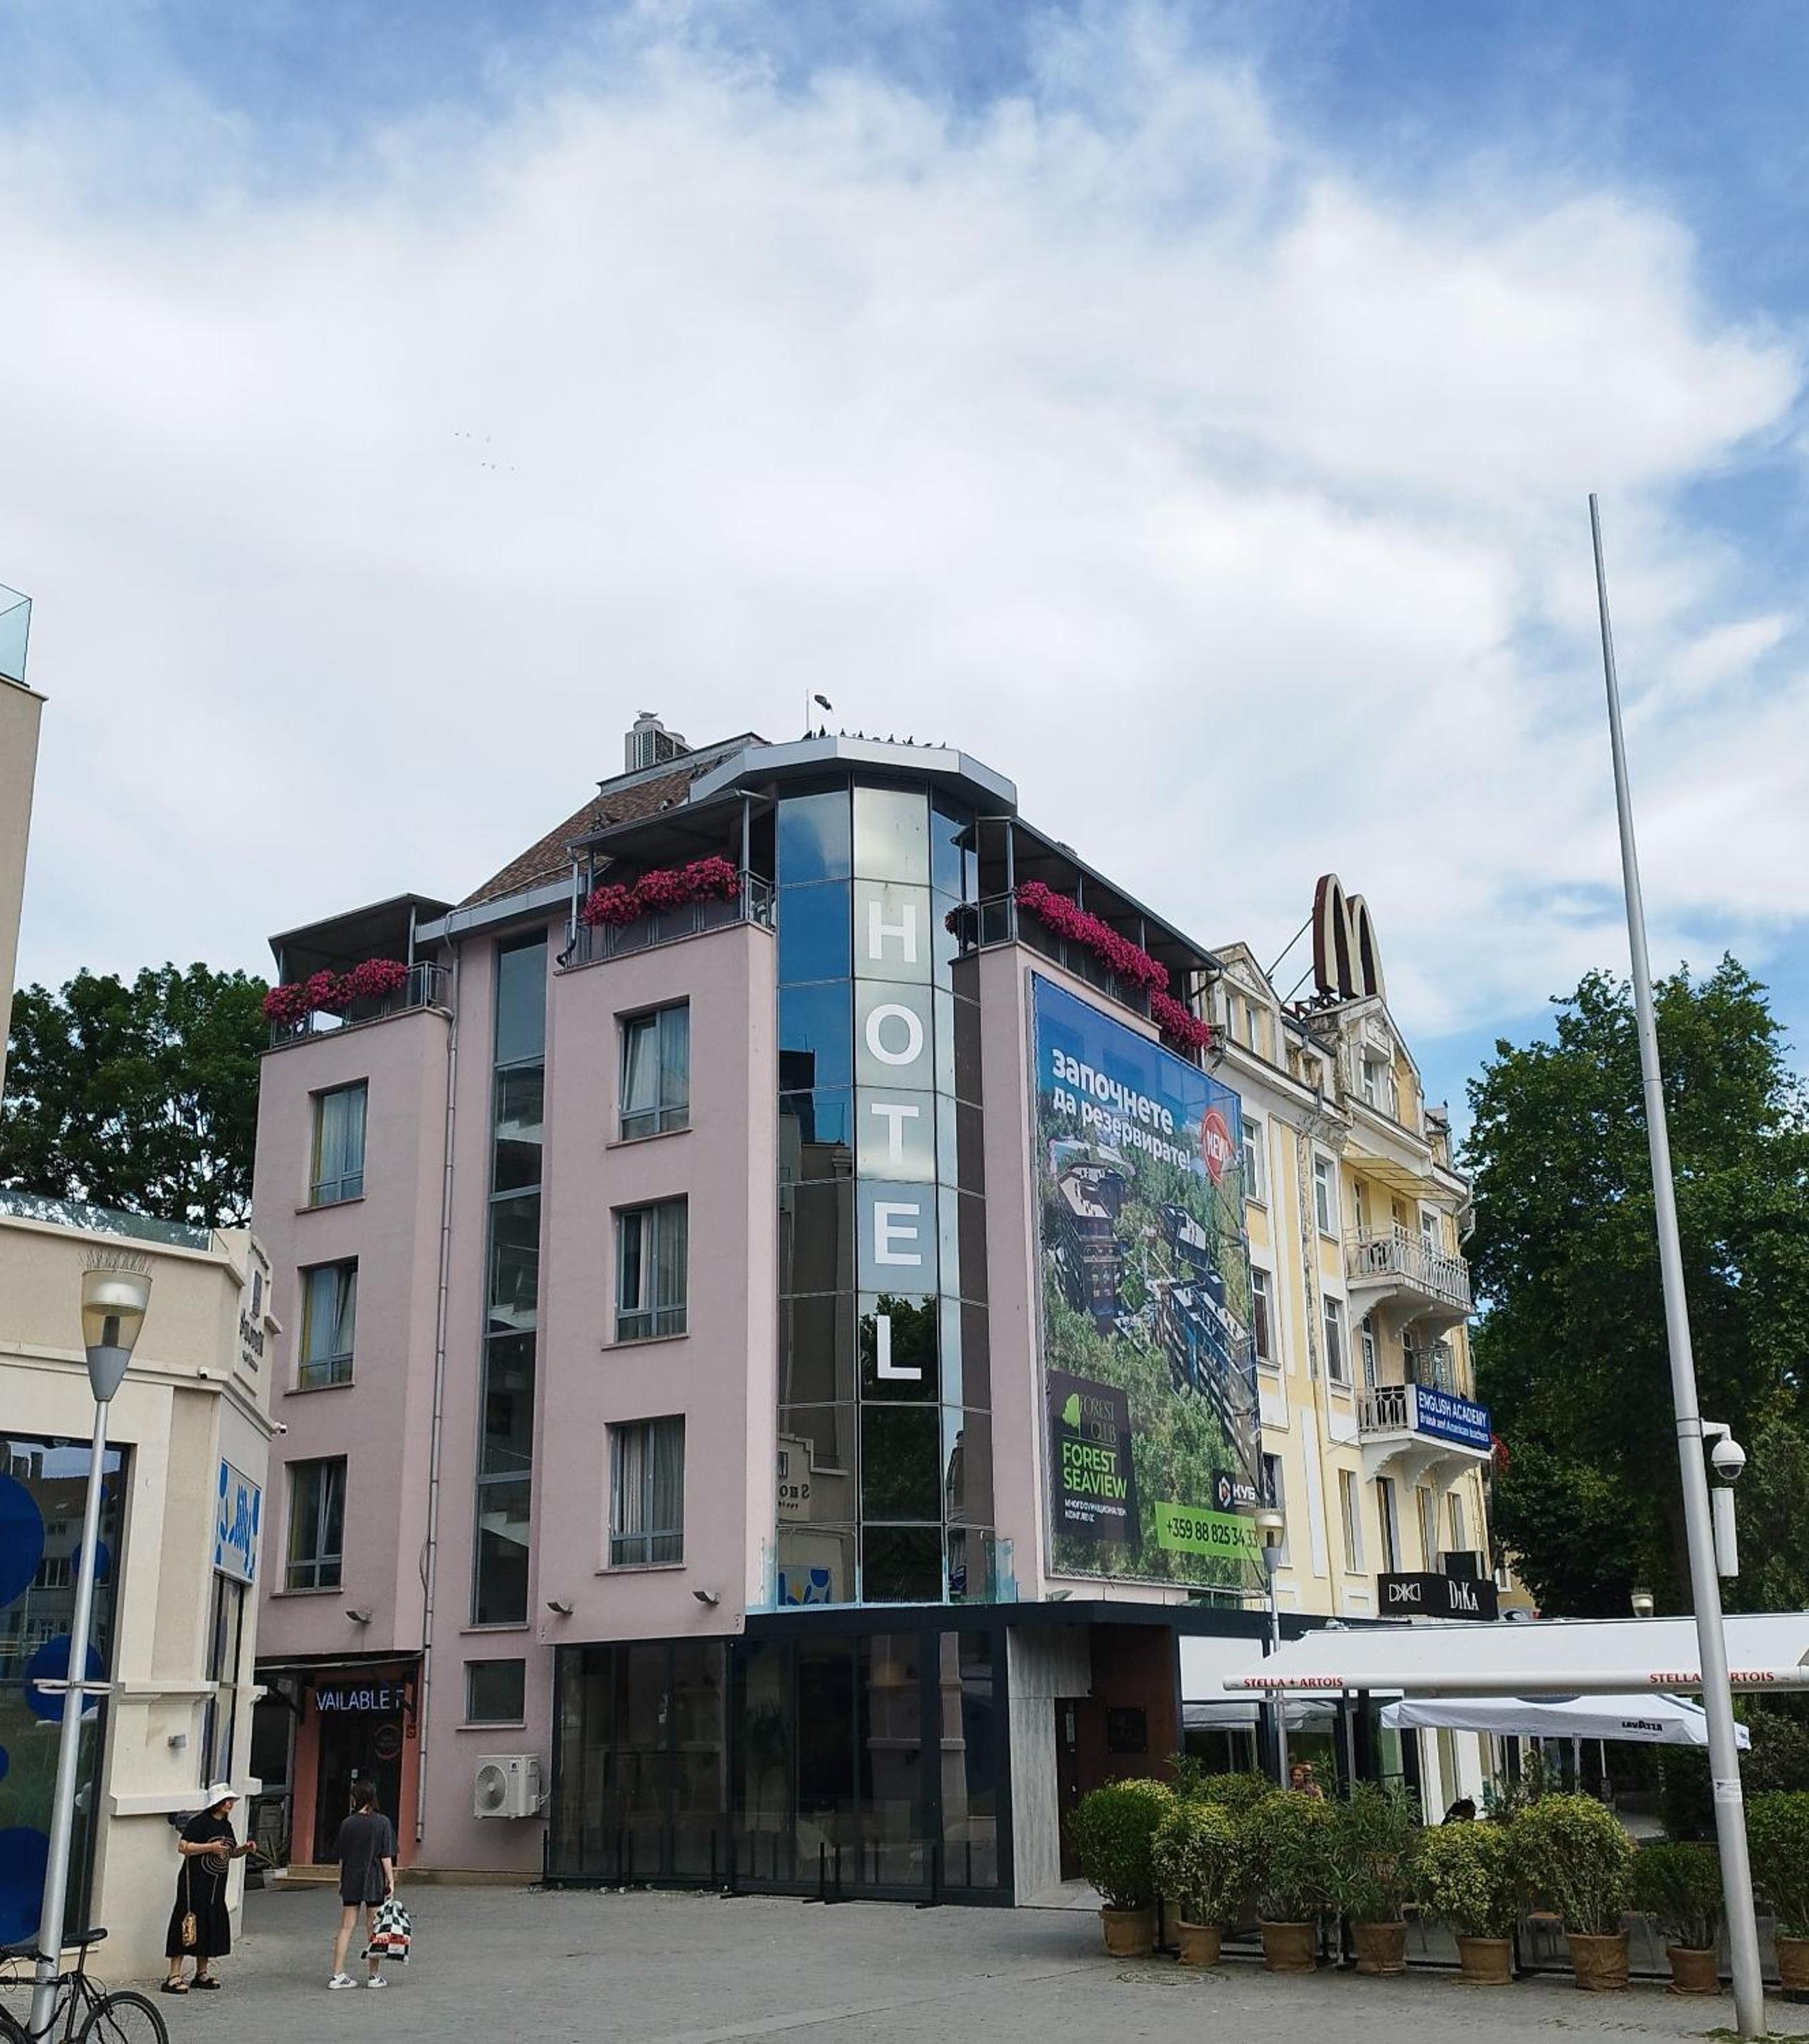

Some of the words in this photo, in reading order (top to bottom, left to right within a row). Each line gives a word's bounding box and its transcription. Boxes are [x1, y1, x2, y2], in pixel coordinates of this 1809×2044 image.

[865, 901, 924, 1380] HOTEL
[1054, 1086, 1076, 1116] да
[1081, 1099, 1191, 1173] резервирате!
[1080, 1395, 1114, 1421] FOREST
[1418, 1391, 1451, 1418] ENGLISH
[1452, 1403, 1487, 1427] ACADEMY
[1437, 1418, 1446, 1430] and
[1063, 1441, 1117, 1474] FOREST
[1063, 1467, 1127, 1500] SEAVIEW
[1233, 1484, 1255, 1500] КУБ
[1167, 1517, 1193, 1539] +359
[1195, 1522, 1209, 1542] 88
[1211, 1524, 1231, 1544] 825
[1232, 1526, 1245, 1547] 34
[1245, 1678, 1285, 1688] STELLA
[1300, 1677, 1344, 1687] ARTOIS
[1650, 1672, 1701, 1683] STELLA
[1731, 1672, 1774, 1682] RTOIS
[315, 1690, 390, 1710] VAILABLE
